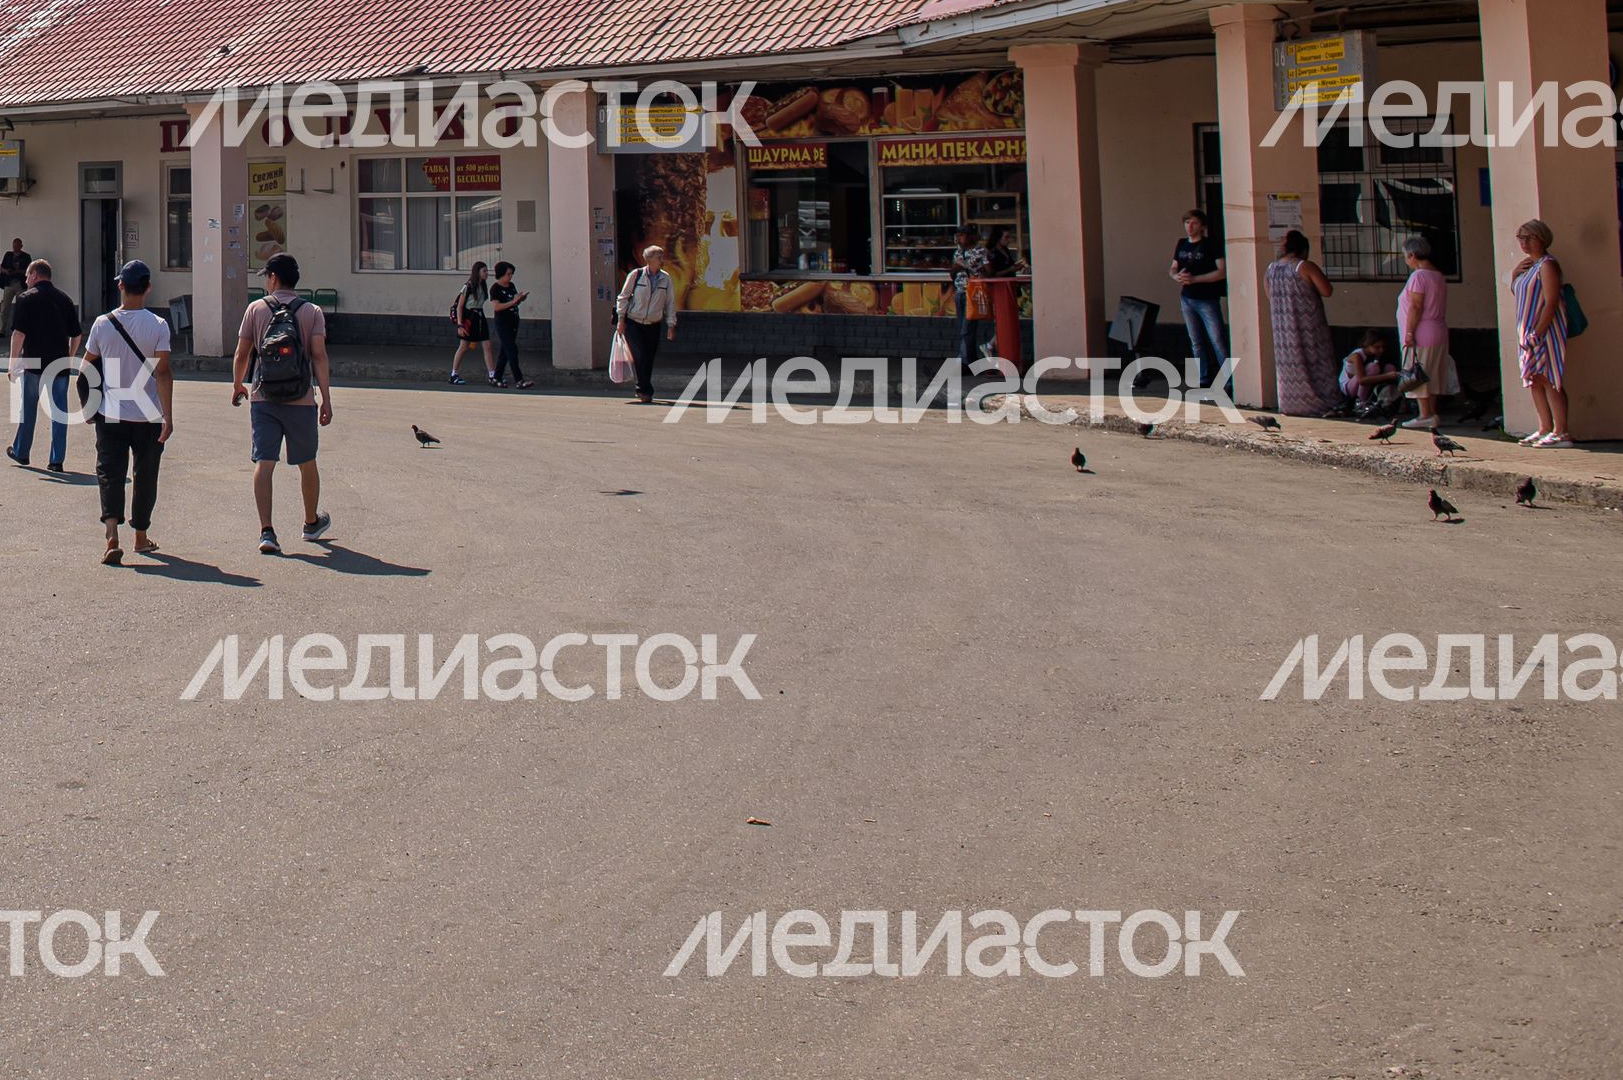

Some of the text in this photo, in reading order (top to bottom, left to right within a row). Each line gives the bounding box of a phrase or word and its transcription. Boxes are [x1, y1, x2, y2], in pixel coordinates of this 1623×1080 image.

[159, 101, 527, 153] ПОДУКТ
[748, 146, 811, 163] ШАУРМА
[881, 142, 937, 160] МИНИ
[457, 174, 499, 183] БЕСПЛАТНО
